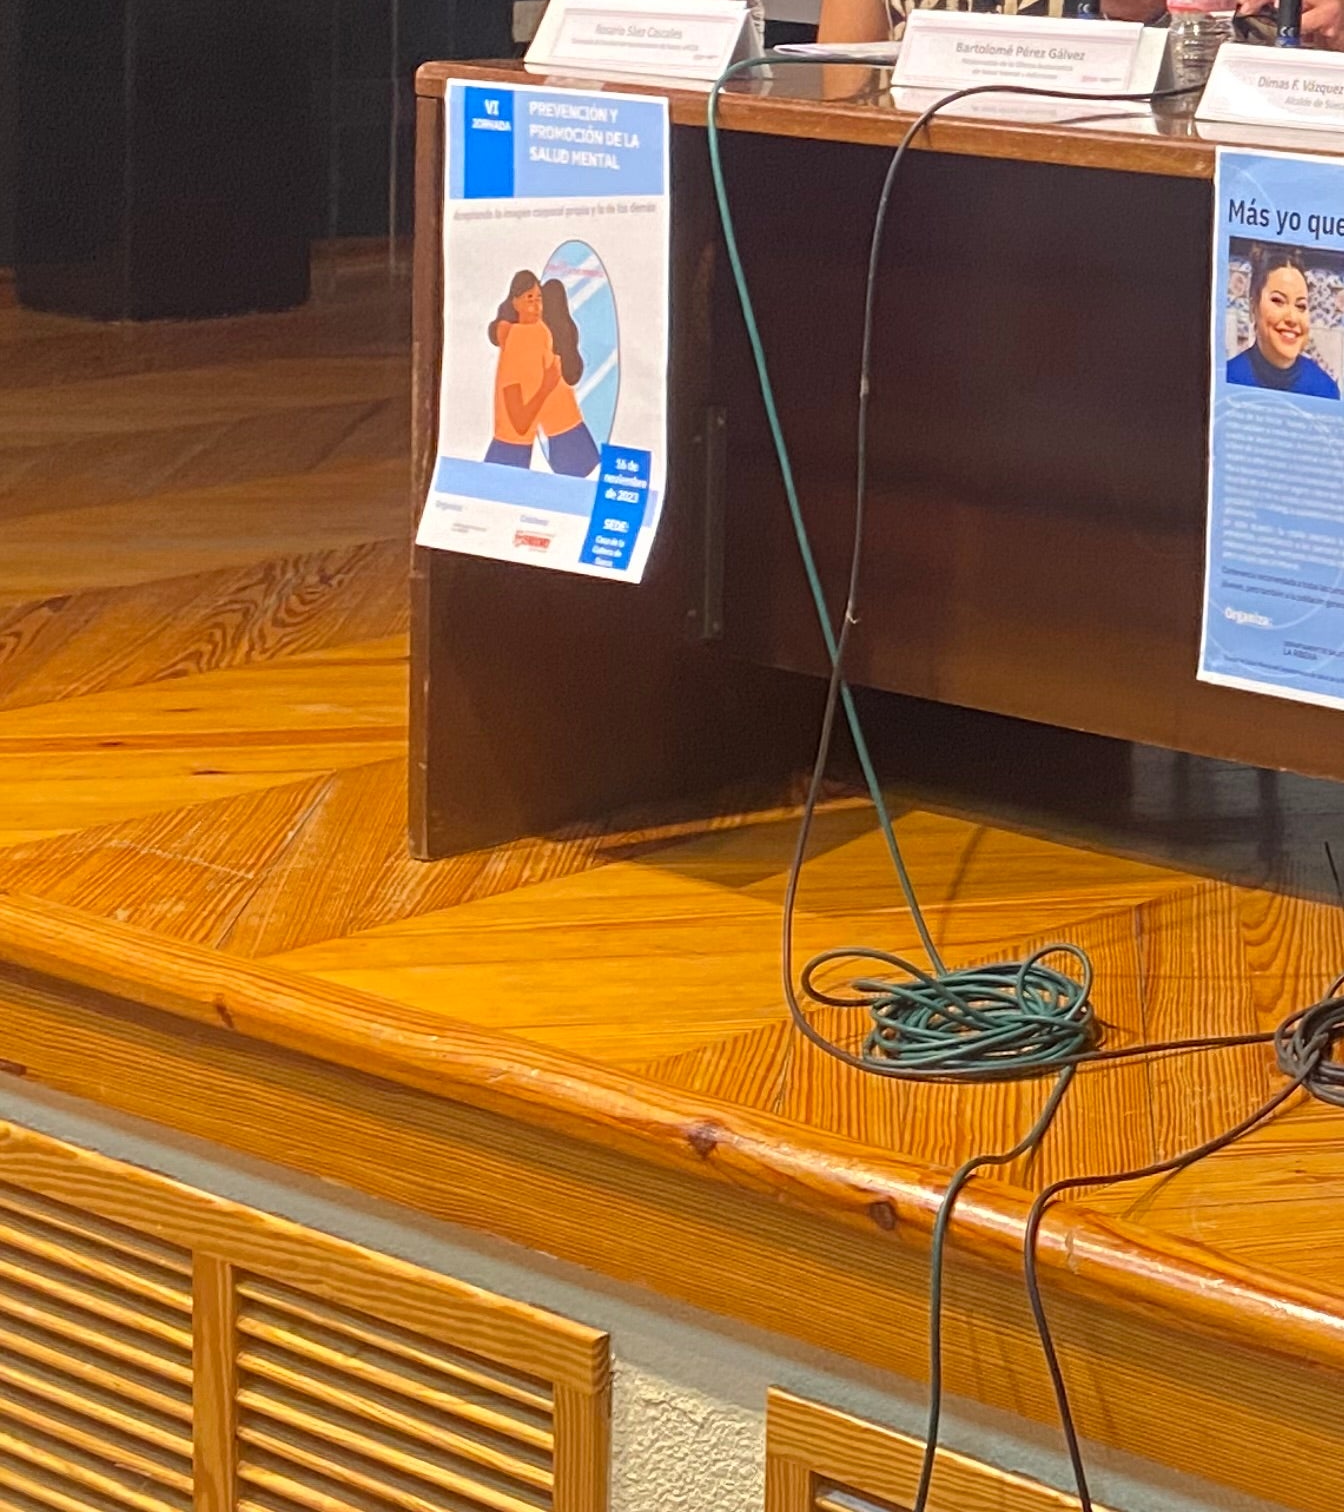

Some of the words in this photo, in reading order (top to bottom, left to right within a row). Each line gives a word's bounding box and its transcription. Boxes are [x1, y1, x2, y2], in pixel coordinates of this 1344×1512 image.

[956, 43, 1013, 57] Bartolomé
[1016, 45, 1046, 59] Pérez
[1048, 47, 1085, 61] Gálvez
[1258, 76, 1290, 90] Dimas
[484, 98, 499, 116] VI
[529, 100, 608, 123] PREVENCIÓN
[608, 107, 618, 124] Y
[529, 123, 605, 146] PROMOCIÓN
[605, 131, 623, 148] DE
[624, 132, 640, 150] LA
[529, 146, 570, 165] SALUD
[571, 149, 621, 170] MENTAL
[1228, 198, 1270, 228] Más
[1276, 209, 1301, 235] yo
